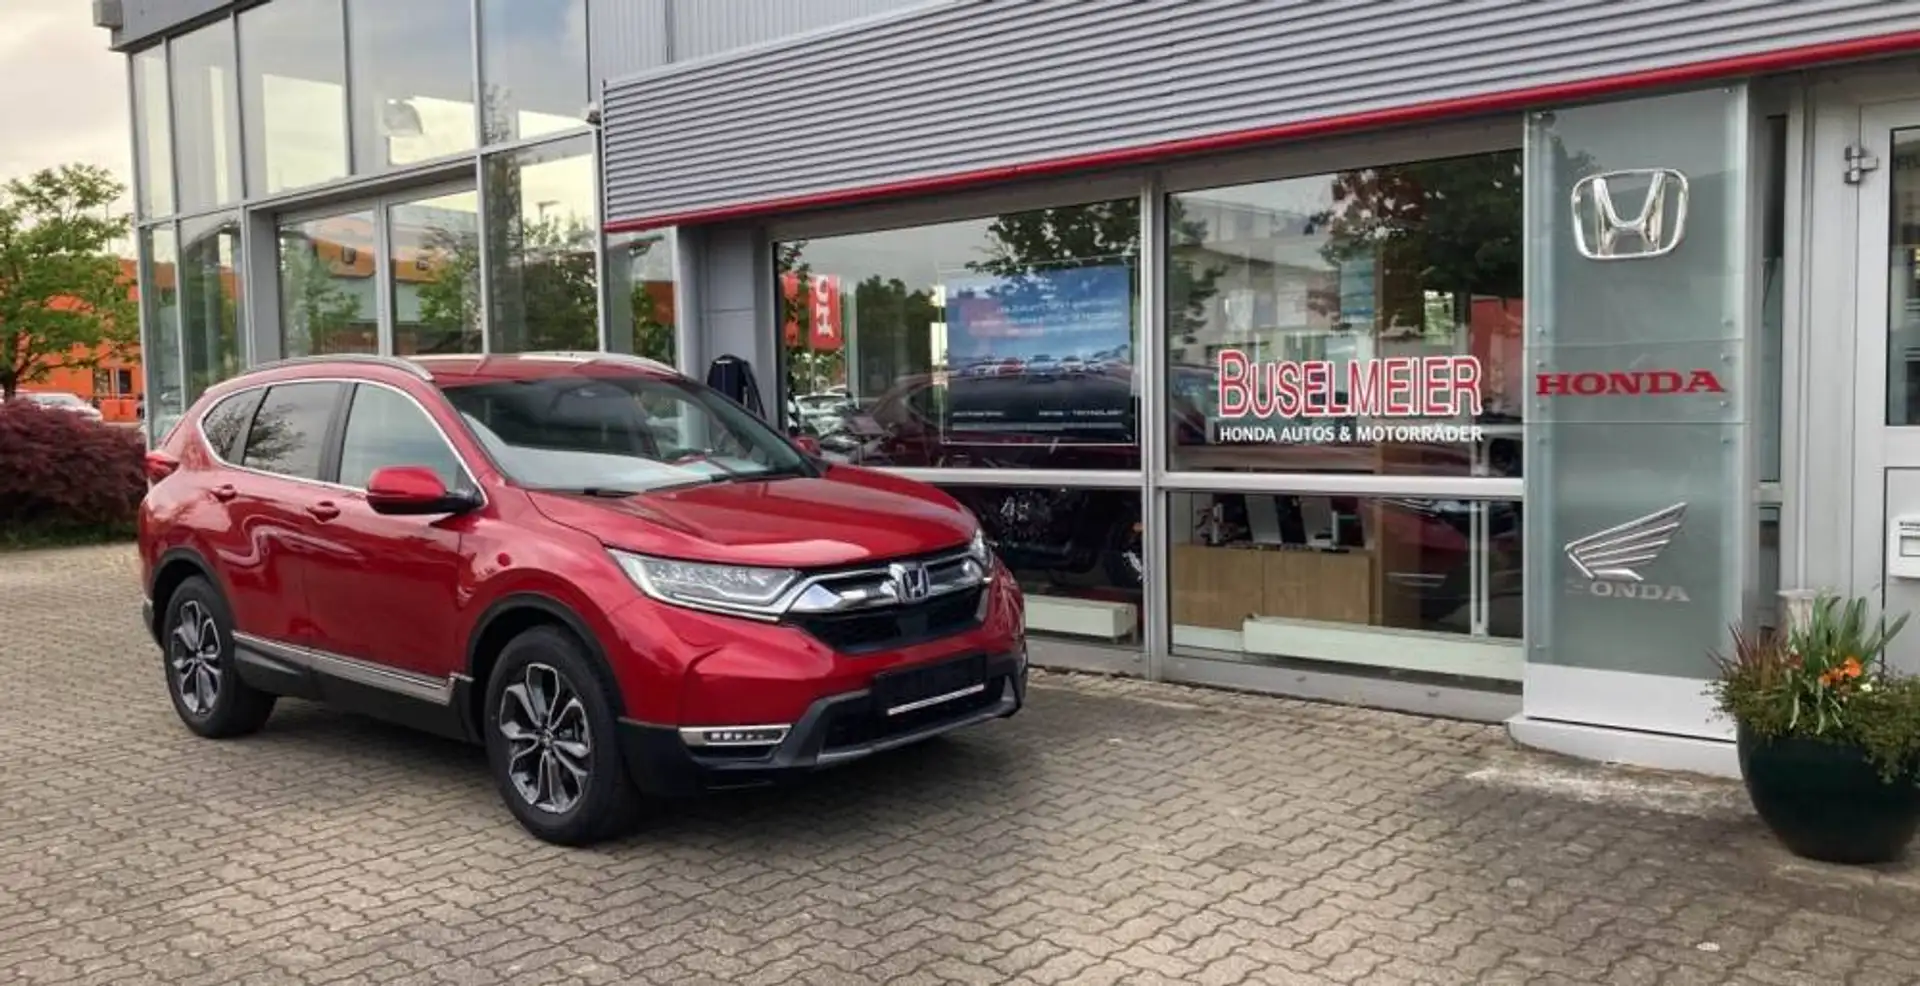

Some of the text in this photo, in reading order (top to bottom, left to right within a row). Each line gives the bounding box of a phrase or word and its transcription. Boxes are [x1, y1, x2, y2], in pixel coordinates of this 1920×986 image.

[1536, 370, 1726, 396] HONDA
[1220, 423, 1484, 442] HONDA AUTOS & MOTORRÄDER
